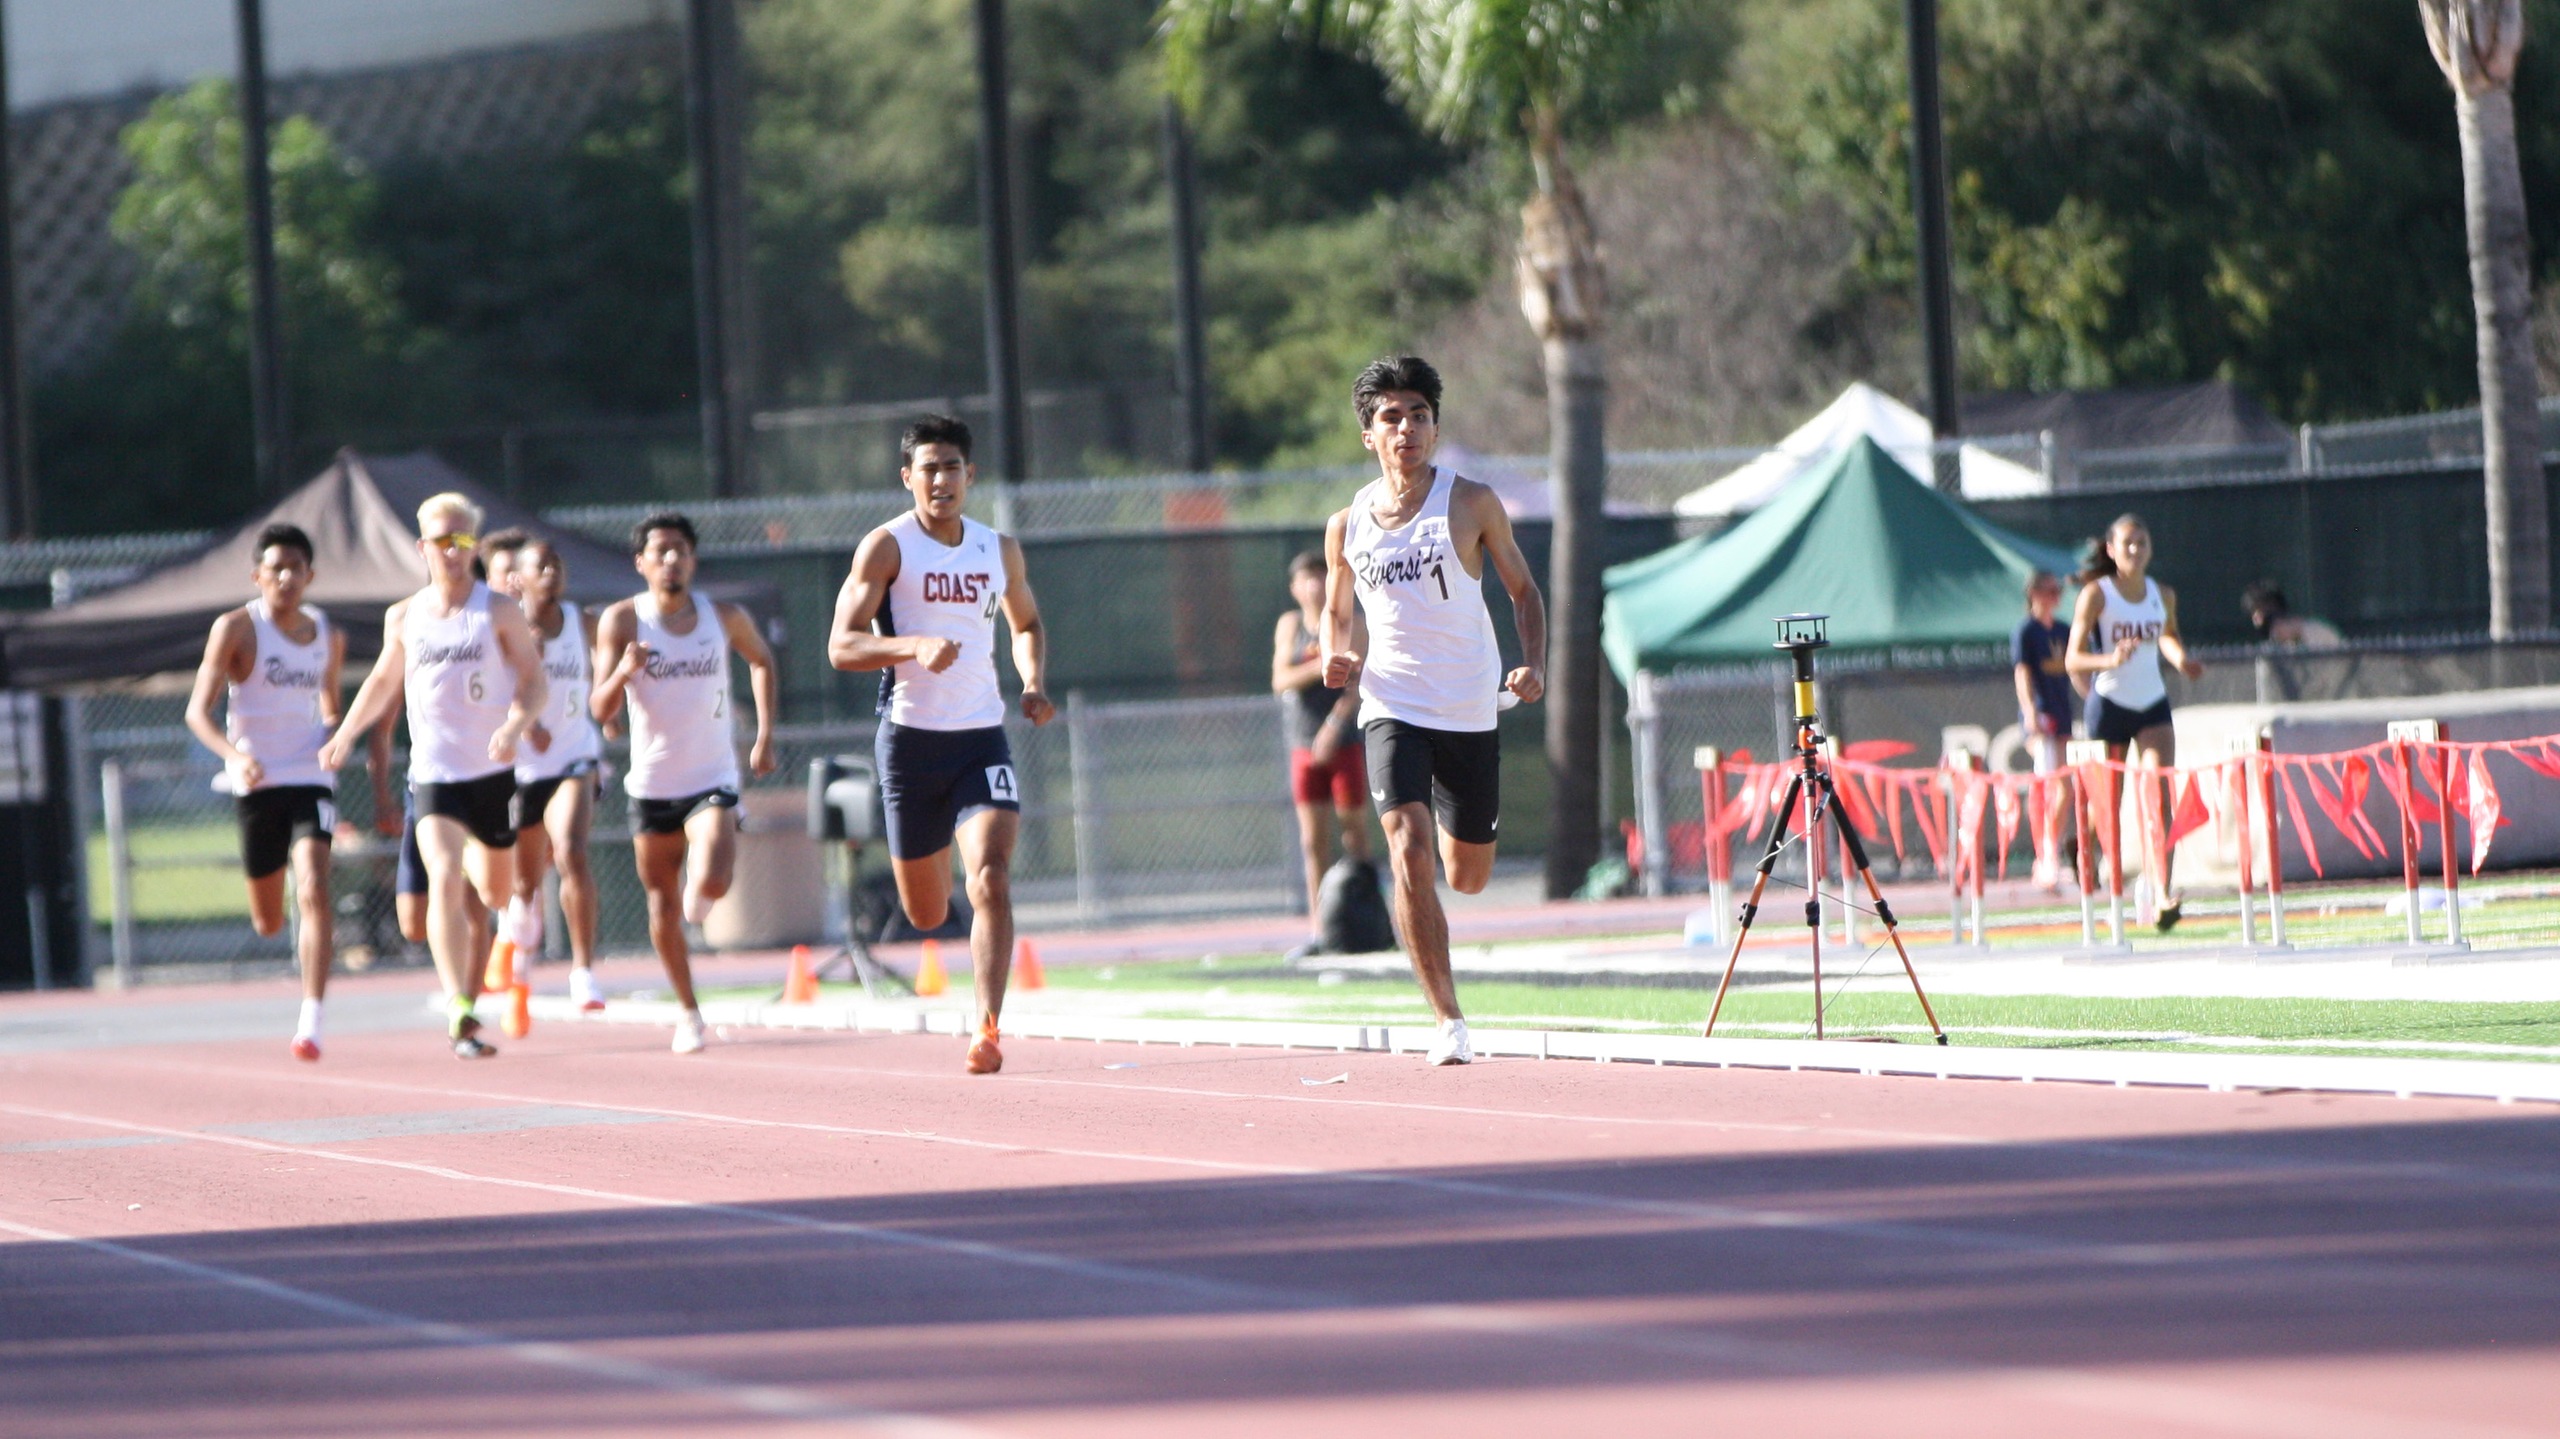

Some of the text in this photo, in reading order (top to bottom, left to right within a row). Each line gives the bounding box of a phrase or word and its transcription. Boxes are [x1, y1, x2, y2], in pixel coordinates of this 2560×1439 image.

[1353, 542, 1444, 590] Riversid
[1430, 562, 1449, 601] 1
[923, 571, 991, 604] COAST
[983, 591, 997, 624] 4
[2111, 621, 2162, 644] COAST
[642, 647, 720, 681] Riverside
[468, 670, 484, 702] 6
[565, 688, 581, 718] 5
[713, 689, 724, 719] 2
[994, 767, 1012, 798] 4
